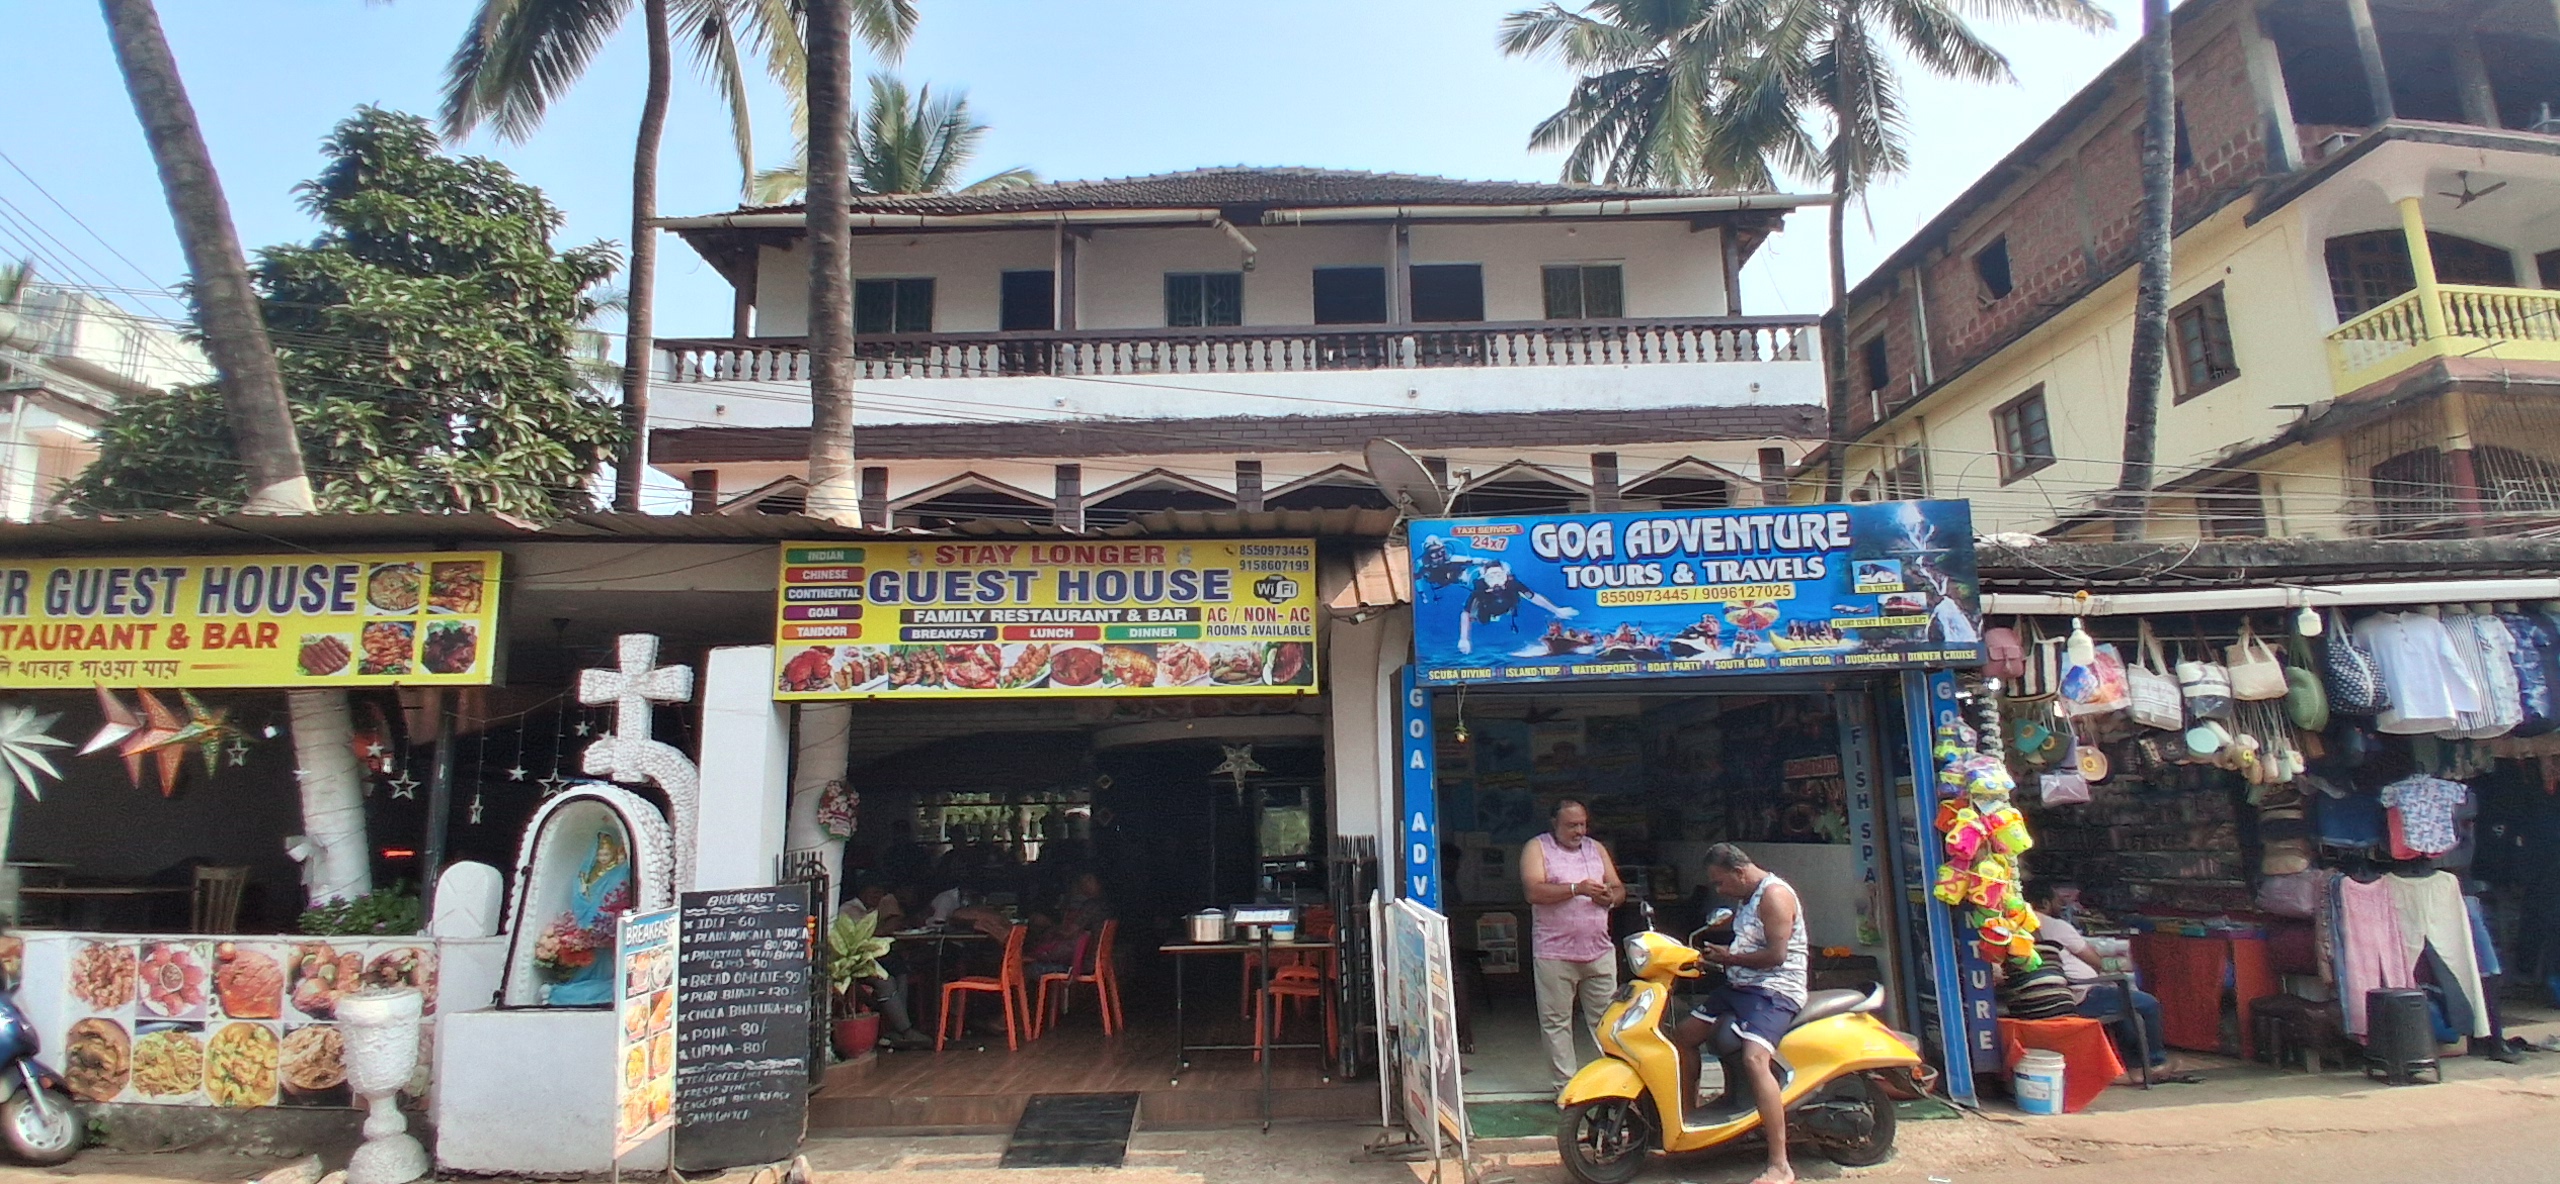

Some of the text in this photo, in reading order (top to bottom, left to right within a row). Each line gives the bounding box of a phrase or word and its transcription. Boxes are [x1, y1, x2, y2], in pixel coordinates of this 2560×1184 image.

[1531, 511, 1851, 560] GOA ADVENTURE
[807, 551, 844, 562] INDIAN
[934, 544, 1167, 566] STAY LONGER
[1239, 544, 1309, 557] 8550973445
[1239, 560, 1309, 572] 9158607199
[1562, 556, 1827, 589] TOURS & TRAVELS
[802, 569, 848, 580] CHINESE
[0, 564, 361, 618] R GUEST HOUSE
[868, 568, 1231, 604] GUEST HOUSE
[788, 587, 861, 599] CONTINENTAL
[1600, 589, 1689, 604] 8550973445
[1701, 585, 1791, 600] 9096127025
[807, 607, 838, 619] GOAN
[913, 608, 1188, 623] FAMILY RESTAURANT & BAR
[1206, 607, 1228, 622] AC
[1289, 606, 1311, 622] AC
[165, 623, 191, 651] &
[202, 622, 280, 650] BAR
[796, 626, 848, 637] TANDOOR
[911, 628, 986, 640] BREAKFAST
[1029, 627, 1075, 639] LUNCH
[1129, 627, 1177, 639] DINNER
[1206, 624, 1312, 637] ROOMS AVAILABLE
[1779, 654, 1832, 667] NORTH GOA
[1907, 649, 1978, 662] DINNER CRUISE
[1571, 663, 1637, 676] WATERSPORTS
[1647, 660, 1701, 673] BOAT PARTY
[1714, 657, 1766, 670] SOUTH GOA
[1428, 668, 1492, 681] SCUBA DIVING
[1505, 665, 1561, 678] ISLAND TRIP
[1409, 688, 1426, 769] GOA
[1850, 726, 1877, 884] FISH SPA
[706, 892, 776, 907] BREAKFAST
[625, 917, 676, 946] BREAKFAST
[690, 971, 731, 988] BREAD
[689, 990, 718, 1003] PURI
[687, 1006, 725, 1022] CHOLA
[691, 1025, 730, 1041] POHA
